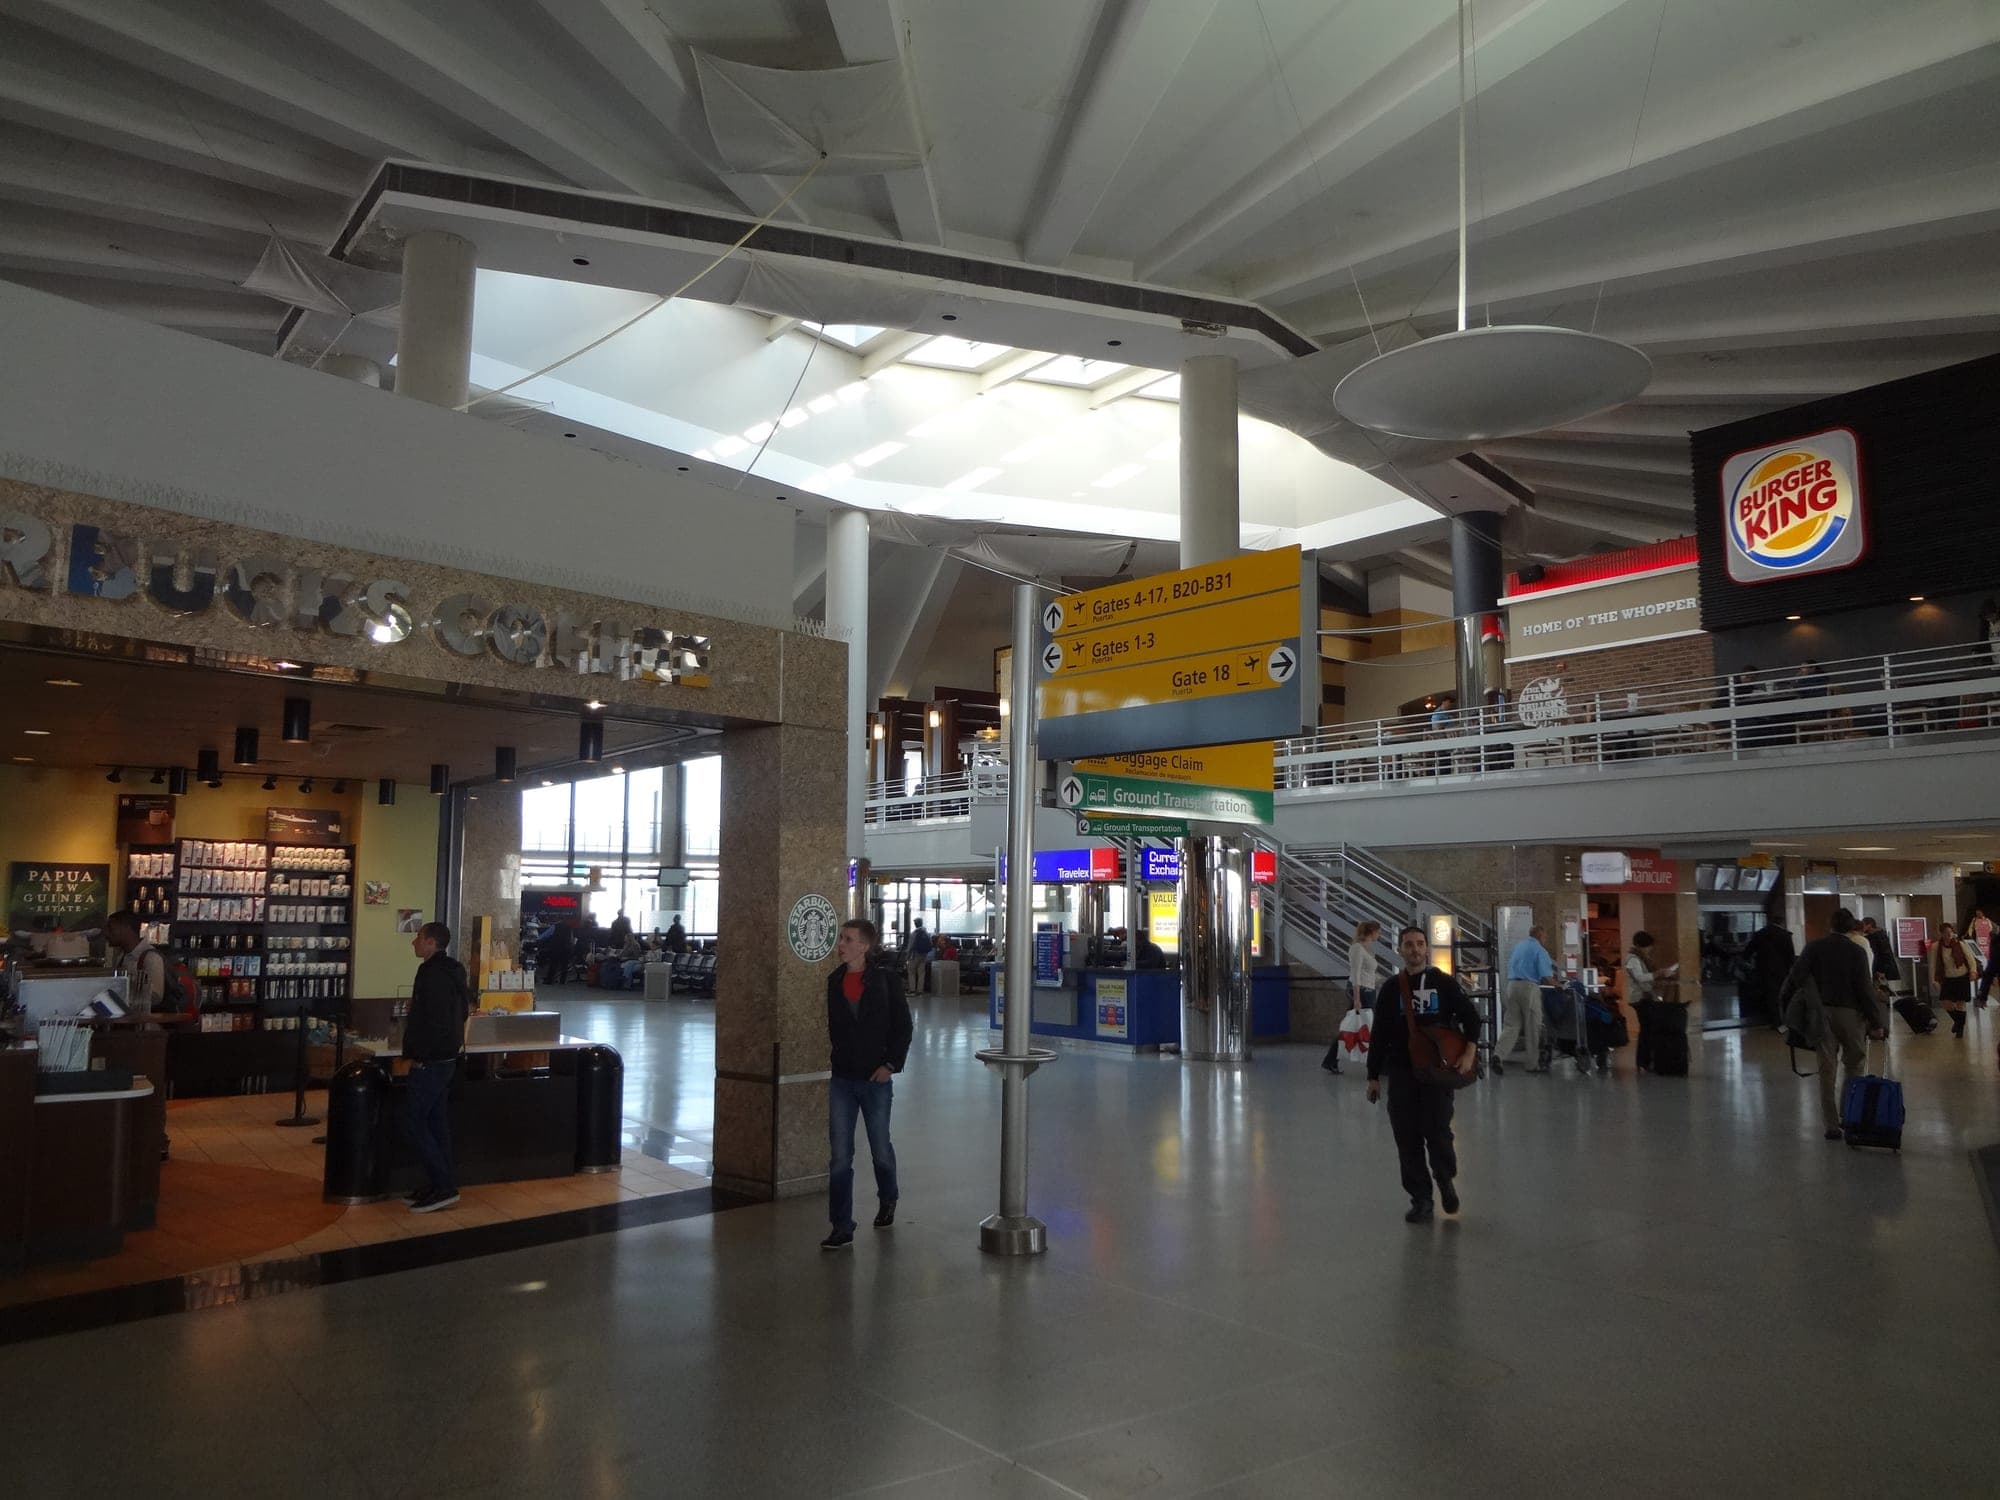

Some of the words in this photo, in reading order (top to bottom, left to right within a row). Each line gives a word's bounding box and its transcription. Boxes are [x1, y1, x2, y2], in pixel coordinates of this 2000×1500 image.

[1738, 459, 1833, 521] BURGER
[1743, 479, 1839, 551] KING
[1092, 596, 1130, 616] Gates
[1134, 586, 1168, 606] 4-17,
[1172, 572, 1233, 600] B20-B31
[1092, 612, 1114, 623] Puertas
[1522, 620, 1562, 637] HOME
[1566, 616, 1585, 629] OF
[1588, 611, 1618, 625] THE
[1621, 597, 1698, 620] WHOPPER
[431, 593, 713, 689] COFFEE
[1092, 638, 1130, 658] Gates
[1134, 633, 1155, 650] 1-3
[1091, 654, 1113, 665] Puertas
[1172, 668, 1208, 688] Gate
[1213, 664, 1230, 681] 18
[1171, 687, 1193, 697] Puerta
[1114, 753, 1168, 770] Baggage
[1172, 755, 1204, 772] Claim
[1113, 788, 1160, 806] Ground
[1103, 823, 1131, 832] Ground
[1132, 824, 1182, 834] Transportation
[28, 870, 93, 882] PAPUA
[1058, 868, 1089, 879] Travelex
[42, 883, 79, 893] NEW
[23, 893, 95, 903] GUINEA
[791, 897, 836, 927] STARBUCKS
[795, 941, 831, 959] COFFEE
